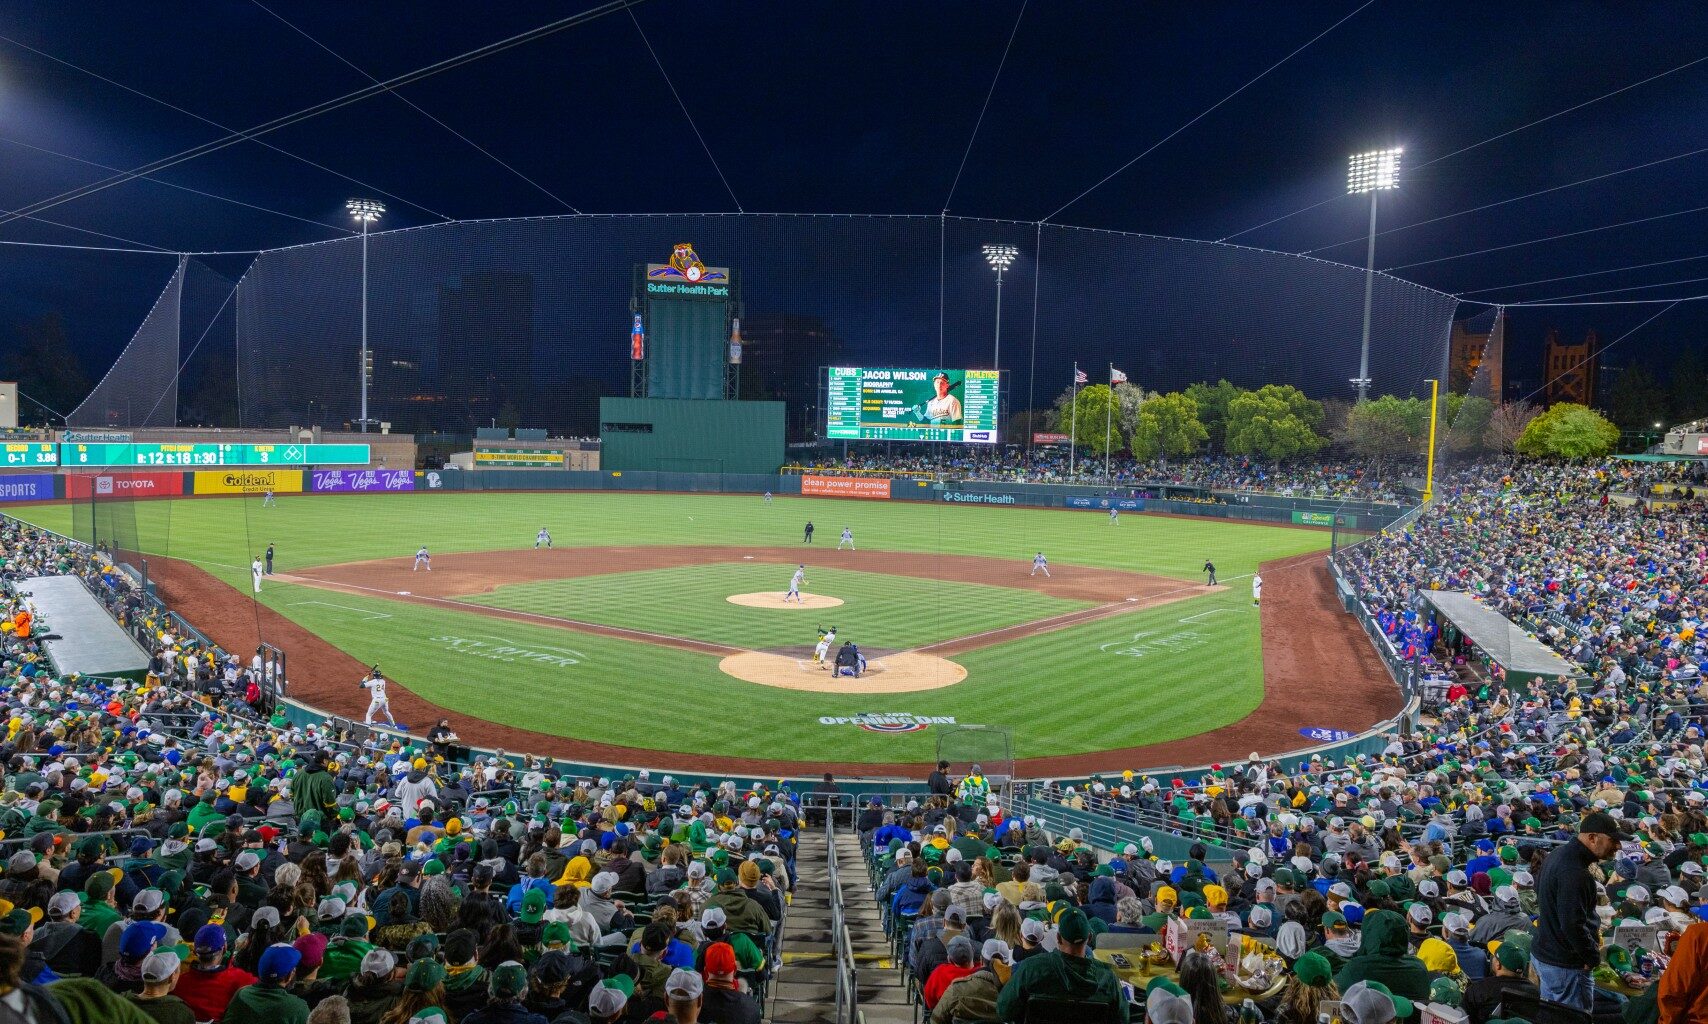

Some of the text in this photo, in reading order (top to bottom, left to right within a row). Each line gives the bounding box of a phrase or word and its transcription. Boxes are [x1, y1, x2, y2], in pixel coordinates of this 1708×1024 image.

[647, 283, 728, 296] Sutter Health Park
[835, 367, 856, 376] CUBS
[862, 370, 927, 380] JACOB WILSON
[965, 371, 999, 379] ATHLETICS
[75, 433, 130, 441] Sutter Health
[8, 453, 26, 463] 0-1
[148, 452, 165, 464] 12
[176, 452, 192, 464] 18
[261, 452, 269, 463] 3
[116, 480, 155, 489] TOYOTA
[314, 472, 346, 490] Vegas
[348, 472, 380, 490] Vegas
[382, 472, 414, 490] Vegas
[804, 478, 888, 490] clean power promise
[0, 483, 36, 497] SPORTS
[953, 492, 1015, 504] Sutter Health
[491, 646, 580, 667] RIVER
[818, 716, 956, 725] OPENING DAY
